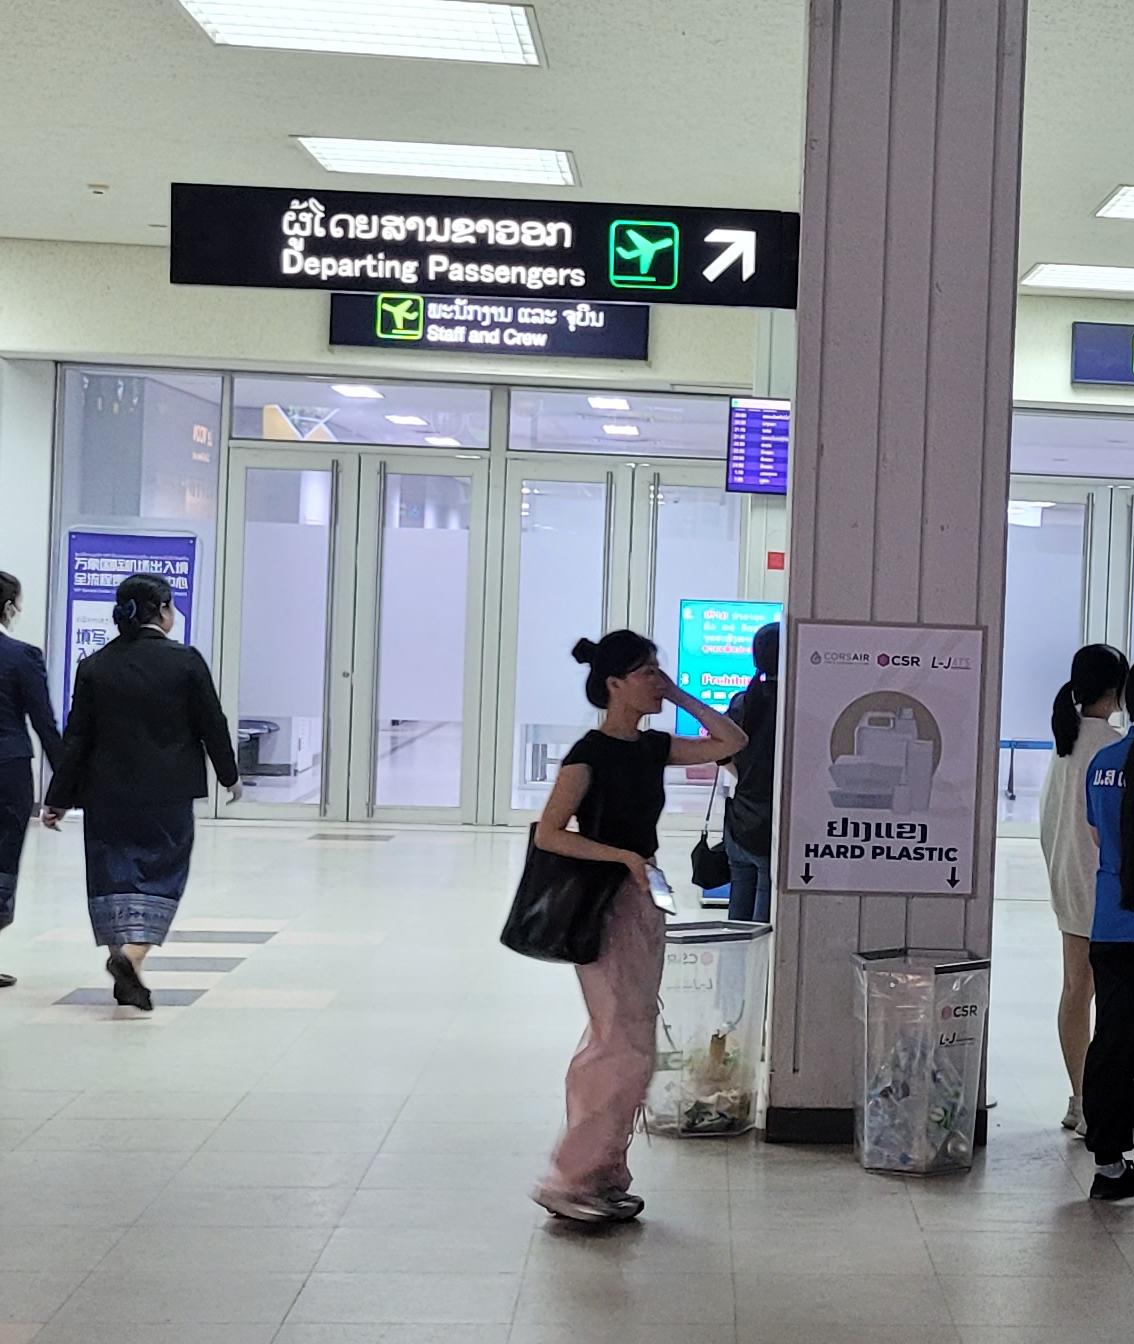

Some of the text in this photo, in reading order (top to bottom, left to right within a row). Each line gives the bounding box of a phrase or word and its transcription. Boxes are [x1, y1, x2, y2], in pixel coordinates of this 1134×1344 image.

[281, 249, 586, 290] Departing Passengers
[426, 324, 549, 347] Staff and Crew
[891, 656, 921, 667] CSR
[804, 843, 958, 862] HARD PLASTIC
[953, 1004, 978, 1018] CSR
